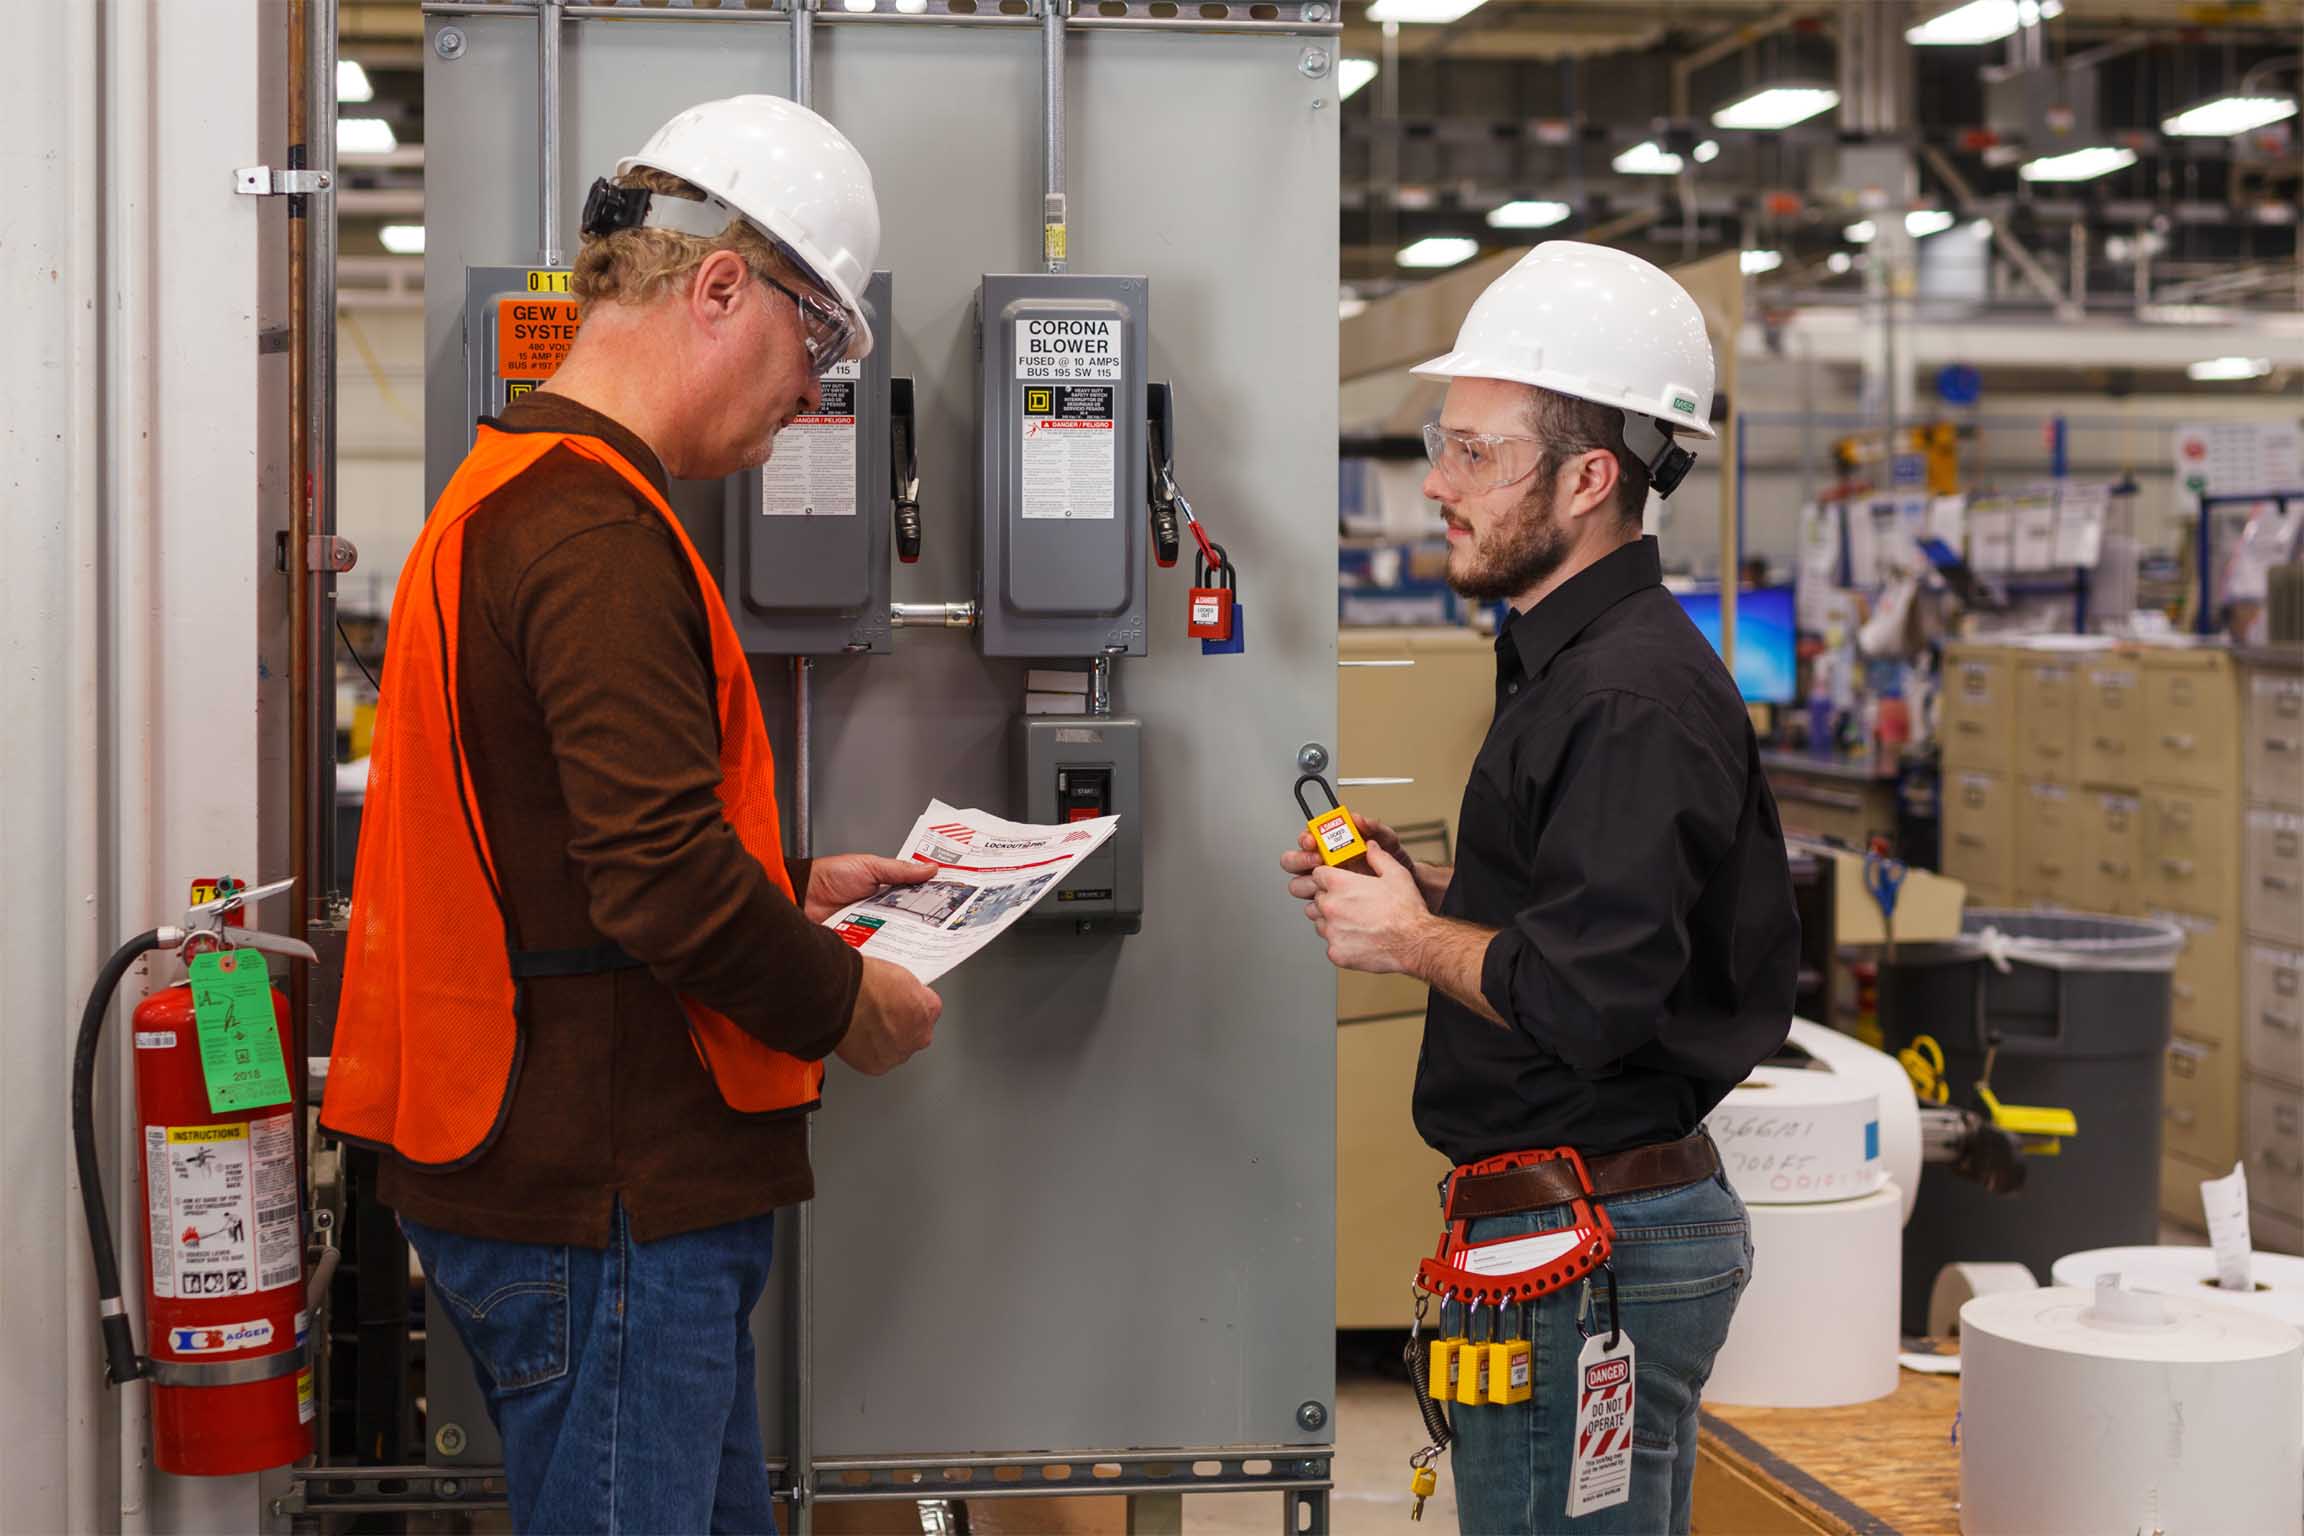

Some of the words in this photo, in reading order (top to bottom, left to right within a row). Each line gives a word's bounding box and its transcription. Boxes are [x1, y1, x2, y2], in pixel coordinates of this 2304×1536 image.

[514, 306, 556, 320] GEW
[566, 306, 578, 320] U
[515, 325, 580, 339] SYSTE
[1029, 321, 1109, 335] CORONA
[1030, 340, 1108, 353] BLOWER
[1019, 357, 1055, 366] FUSED
[1059, 357, 1069, 367] @
[1075, 358, 1084, 366] 10
[1089, 358, 1119, 366] AMPS
[1027, 368, 1049, 376] BUS
[1055, 368, 1070, 376] 195
[1075, 368, 1091, 376] SW
[1097, 368, 1111, 377] 115
[174, 1128, 240, 1140] INSTRUCTIONS
[1590, 1364, 1625, 1385] DANGER
[1592, 1403, 1604, 1417] DO
[1606, 1398, 1622, 1413] NOT
[1588, 1413, 1624, 1434] OPERATE
